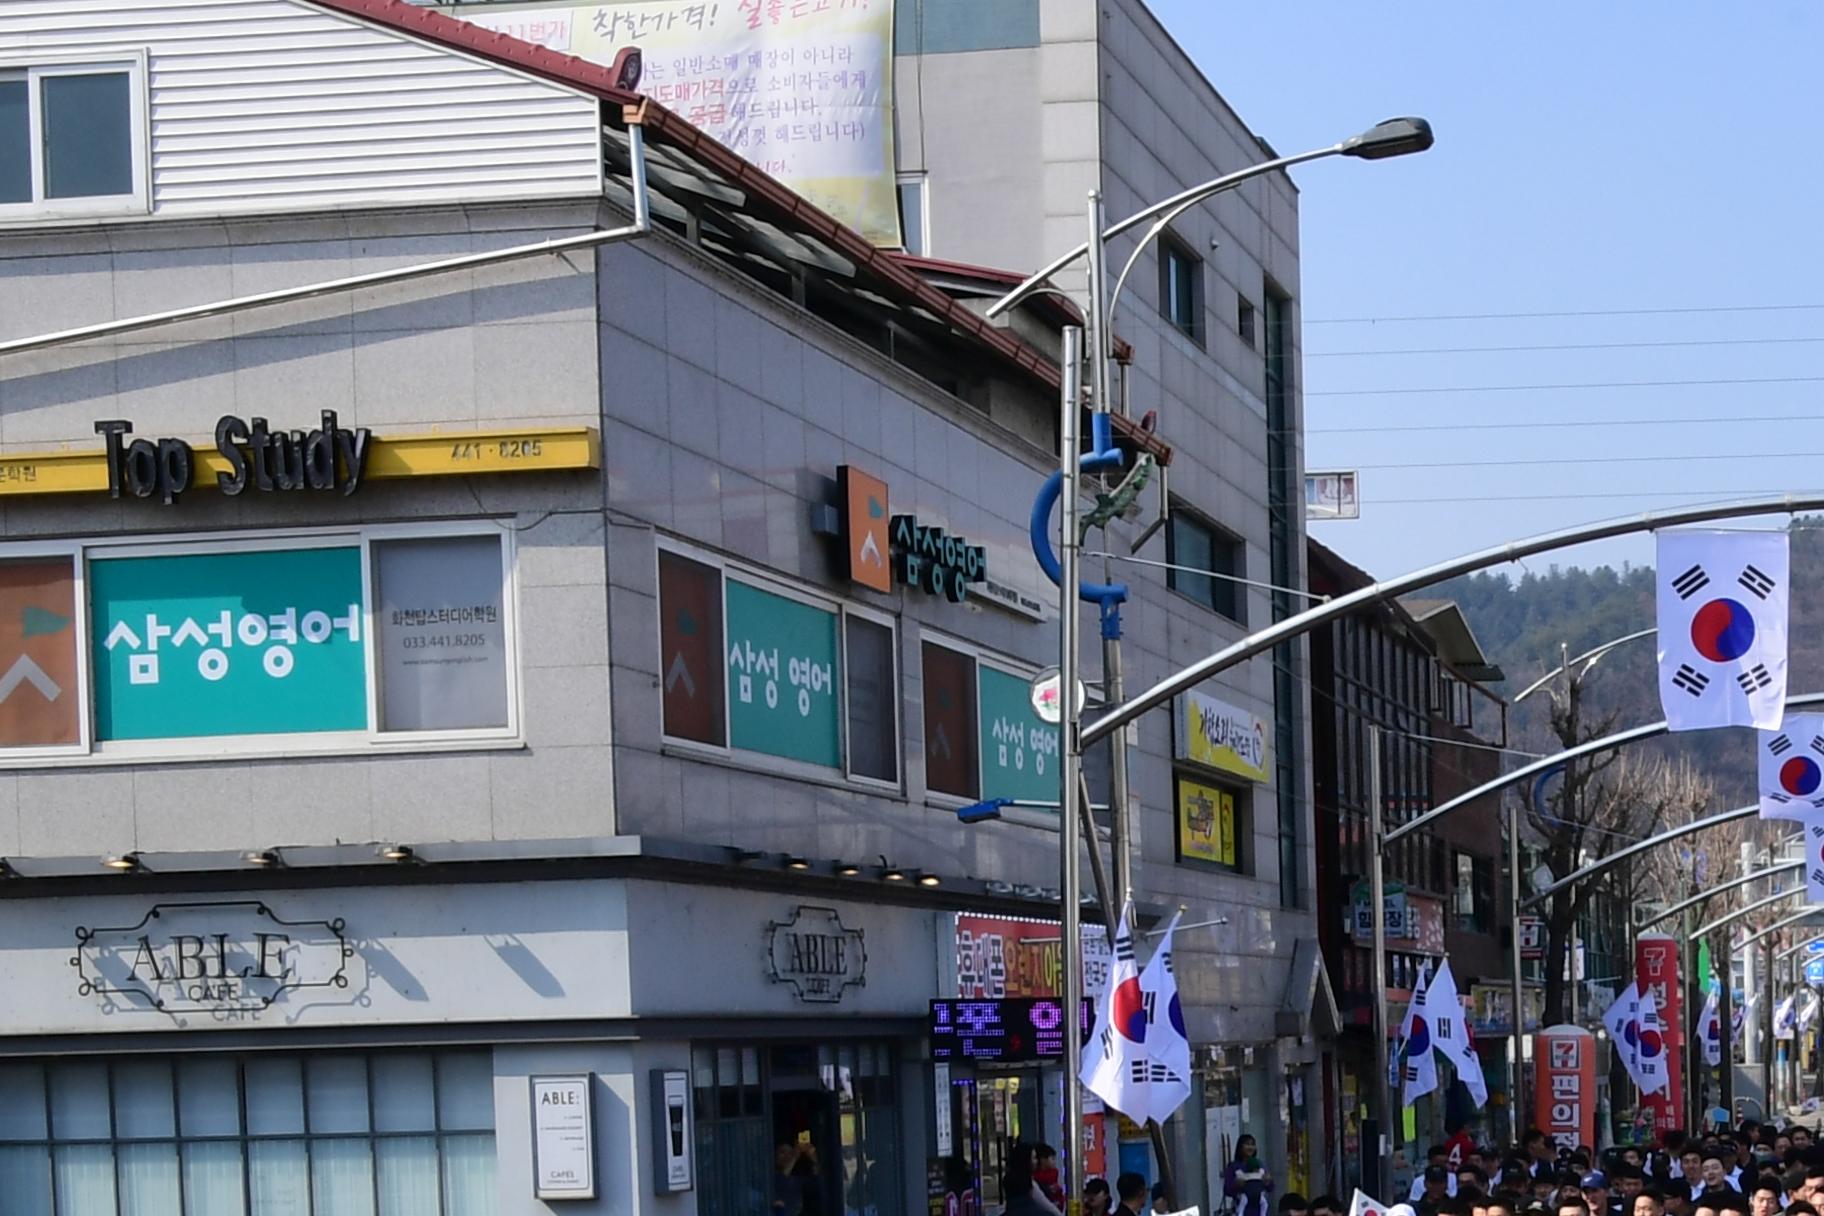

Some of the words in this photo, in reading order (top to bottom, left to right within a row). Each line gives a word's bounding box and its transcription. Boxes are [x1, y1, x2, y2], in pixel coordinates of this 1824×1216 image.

[803, 45, 854, 65] 아니라
[95, 419, 194, 504] Top
[215, 409, 372, 497] Study
[894, 515, 987, 603] 삼성영어
[104, 604, 360, 684] 삼성영어
[730, 640, 779, 709] 삼성
[788, 656, 832, 717] 영어
[992, 716, 1024, 770] 삼성
[1030, 727, 1059, 775] 영어
[126, 932, 291, 981] ABLE
[782, 932, 848, 975] ABLE
[188, 983, 240, 1001] CAFE
